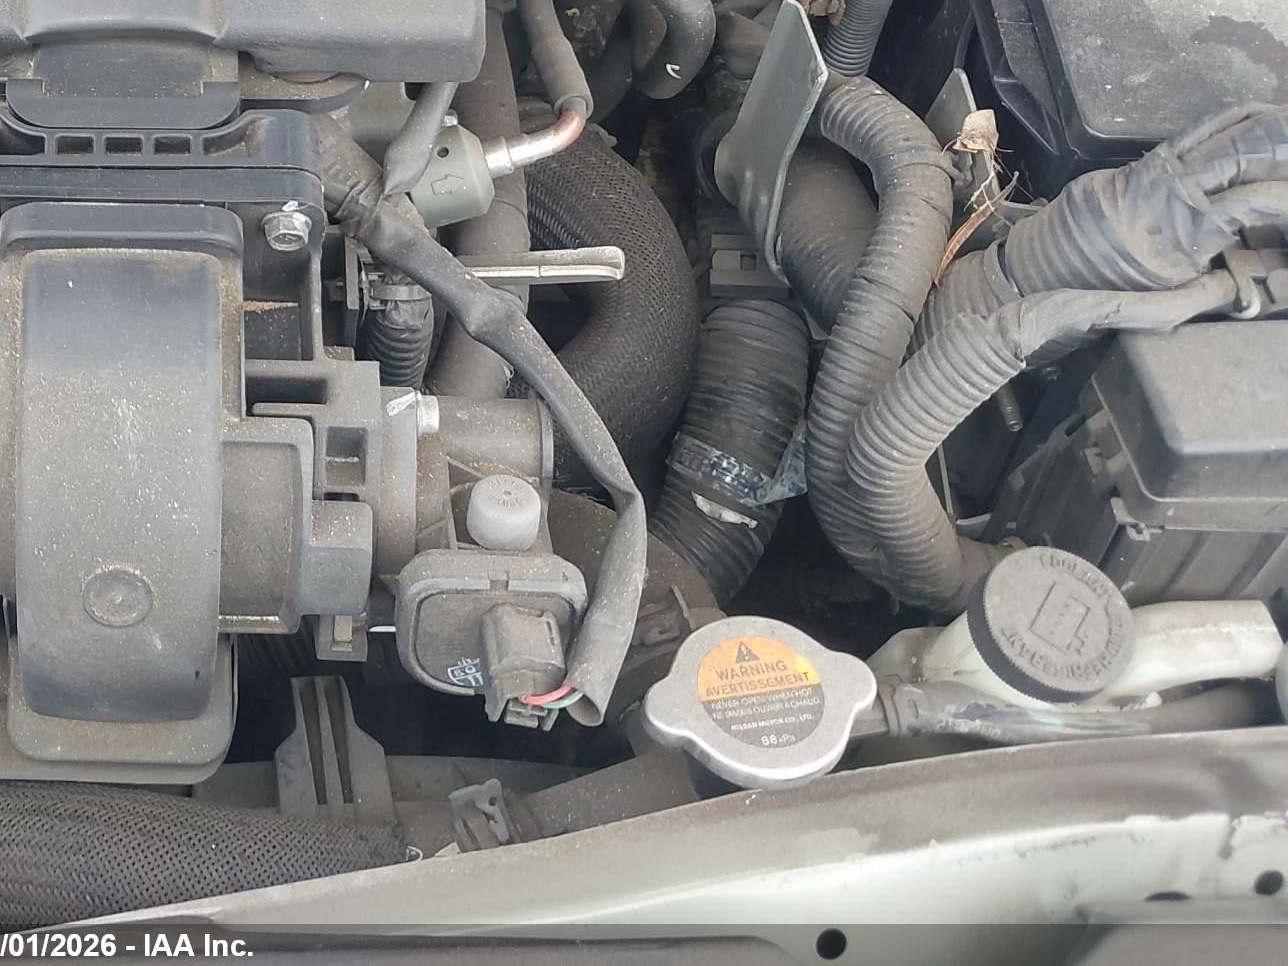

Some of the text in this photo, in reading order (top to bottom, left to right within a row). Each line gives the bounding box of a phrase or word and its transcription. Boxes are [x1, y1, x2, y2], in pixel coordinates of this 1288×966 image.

[715, 660, 788, 681] WARNING
[705, 671, 810, 697] AVERTISSEMENT
[711, 699, 740, 710] NEVER
[731, 721, 757, 731] NISSAN
